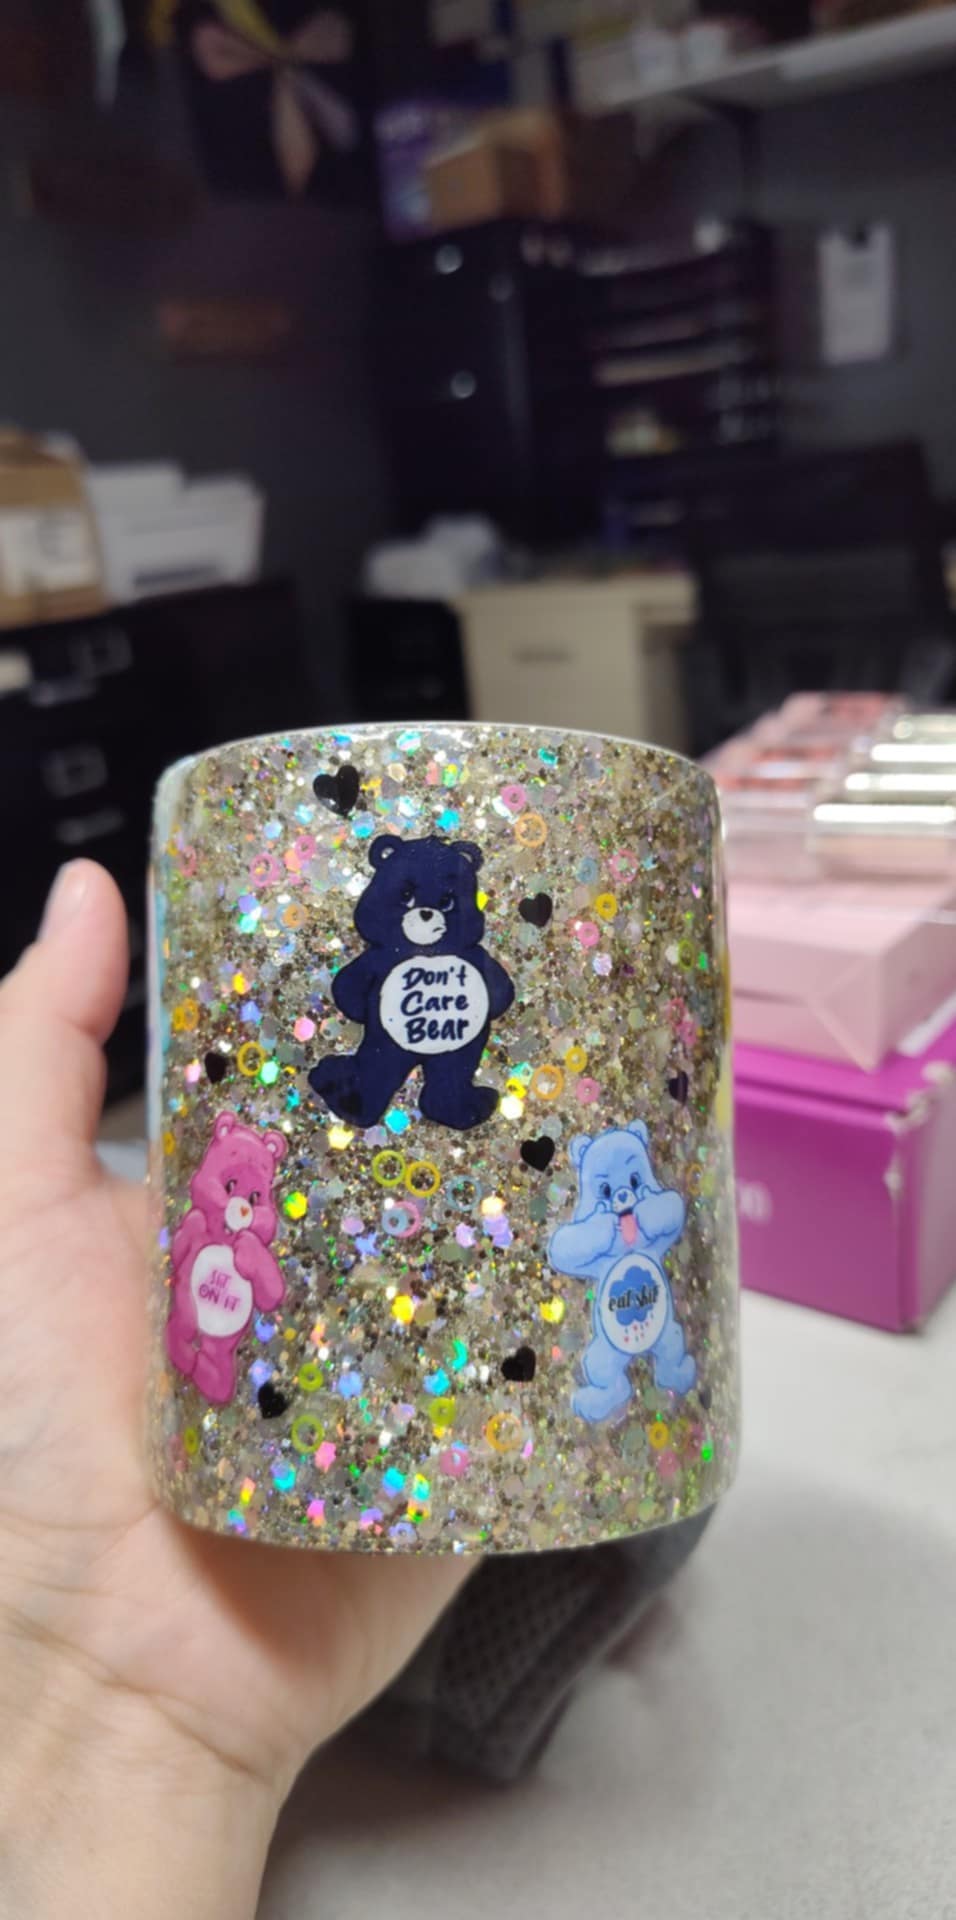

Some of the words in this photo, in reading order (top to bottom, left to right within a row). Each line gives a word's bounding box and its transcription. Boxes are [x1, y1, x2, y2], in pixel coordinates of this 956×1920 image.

[402, 964, 467, 990] Don't
[401, 990, 469, 1016] Care
[404, 1017, 469, 1044] Bear
[199, 1283, 219, 1304] ON
[223, 1295, 241, 1312] IT
[608, 1288, 632, 1312] eat
